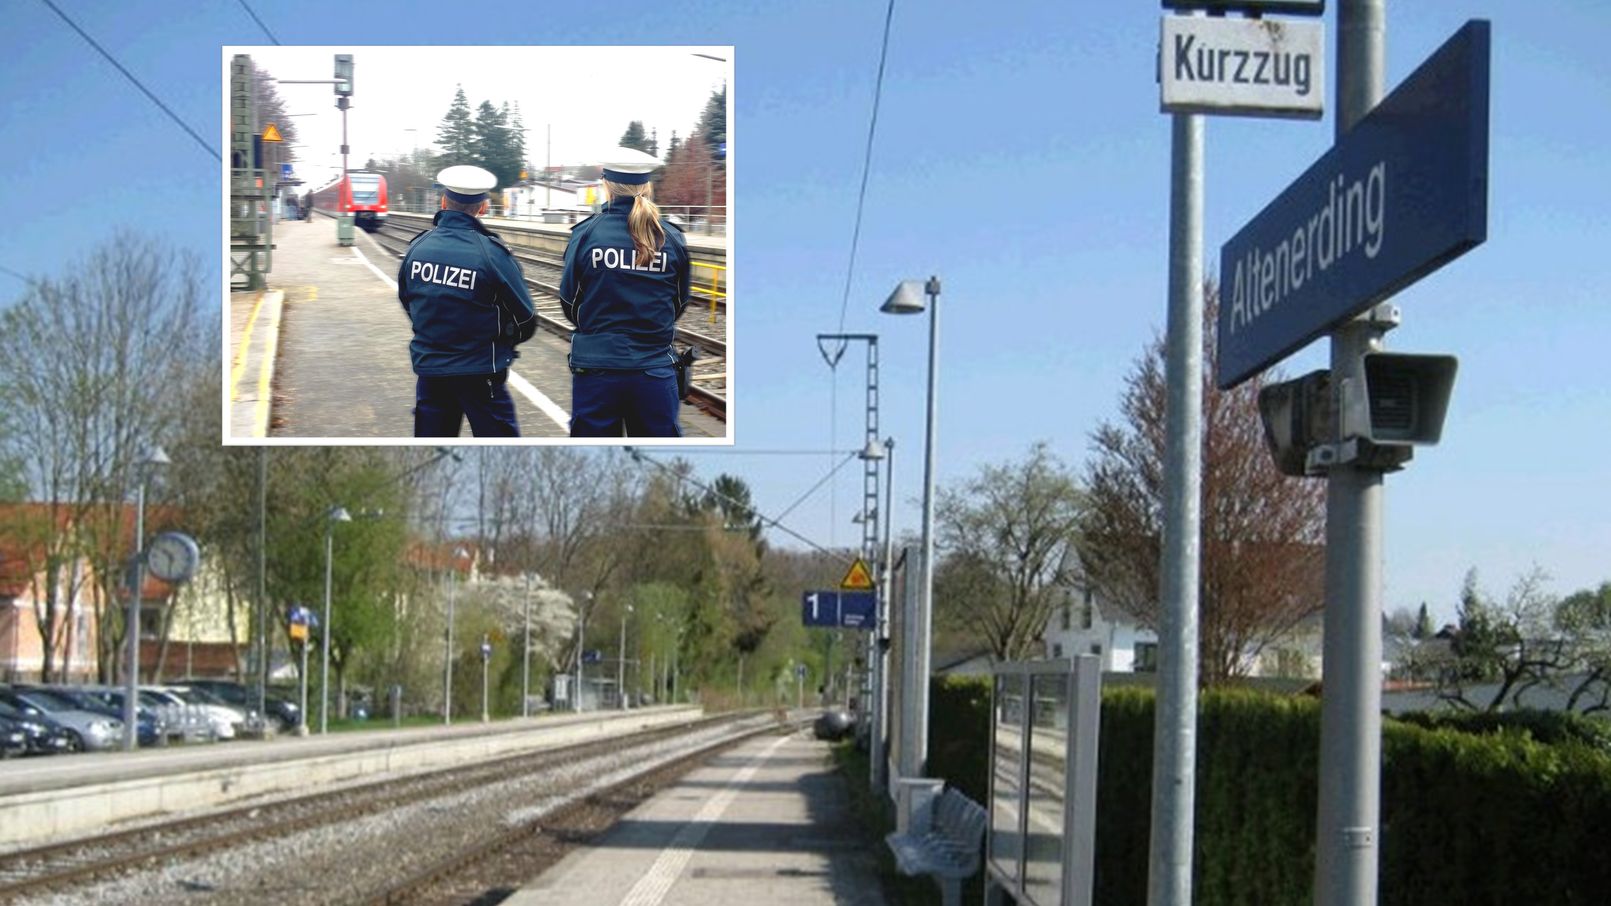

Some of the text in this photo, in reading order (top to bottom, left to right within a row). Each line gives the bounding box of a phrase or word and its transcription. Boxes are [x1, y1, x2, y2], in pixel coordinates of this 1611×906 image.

[1175, 34, 1311, 95] Kurzzug
[1231, 161, 1386, 334] Altenerding
[411, 260, 477, 290] POLIZEI
[806, 593, 819, 620] 1
